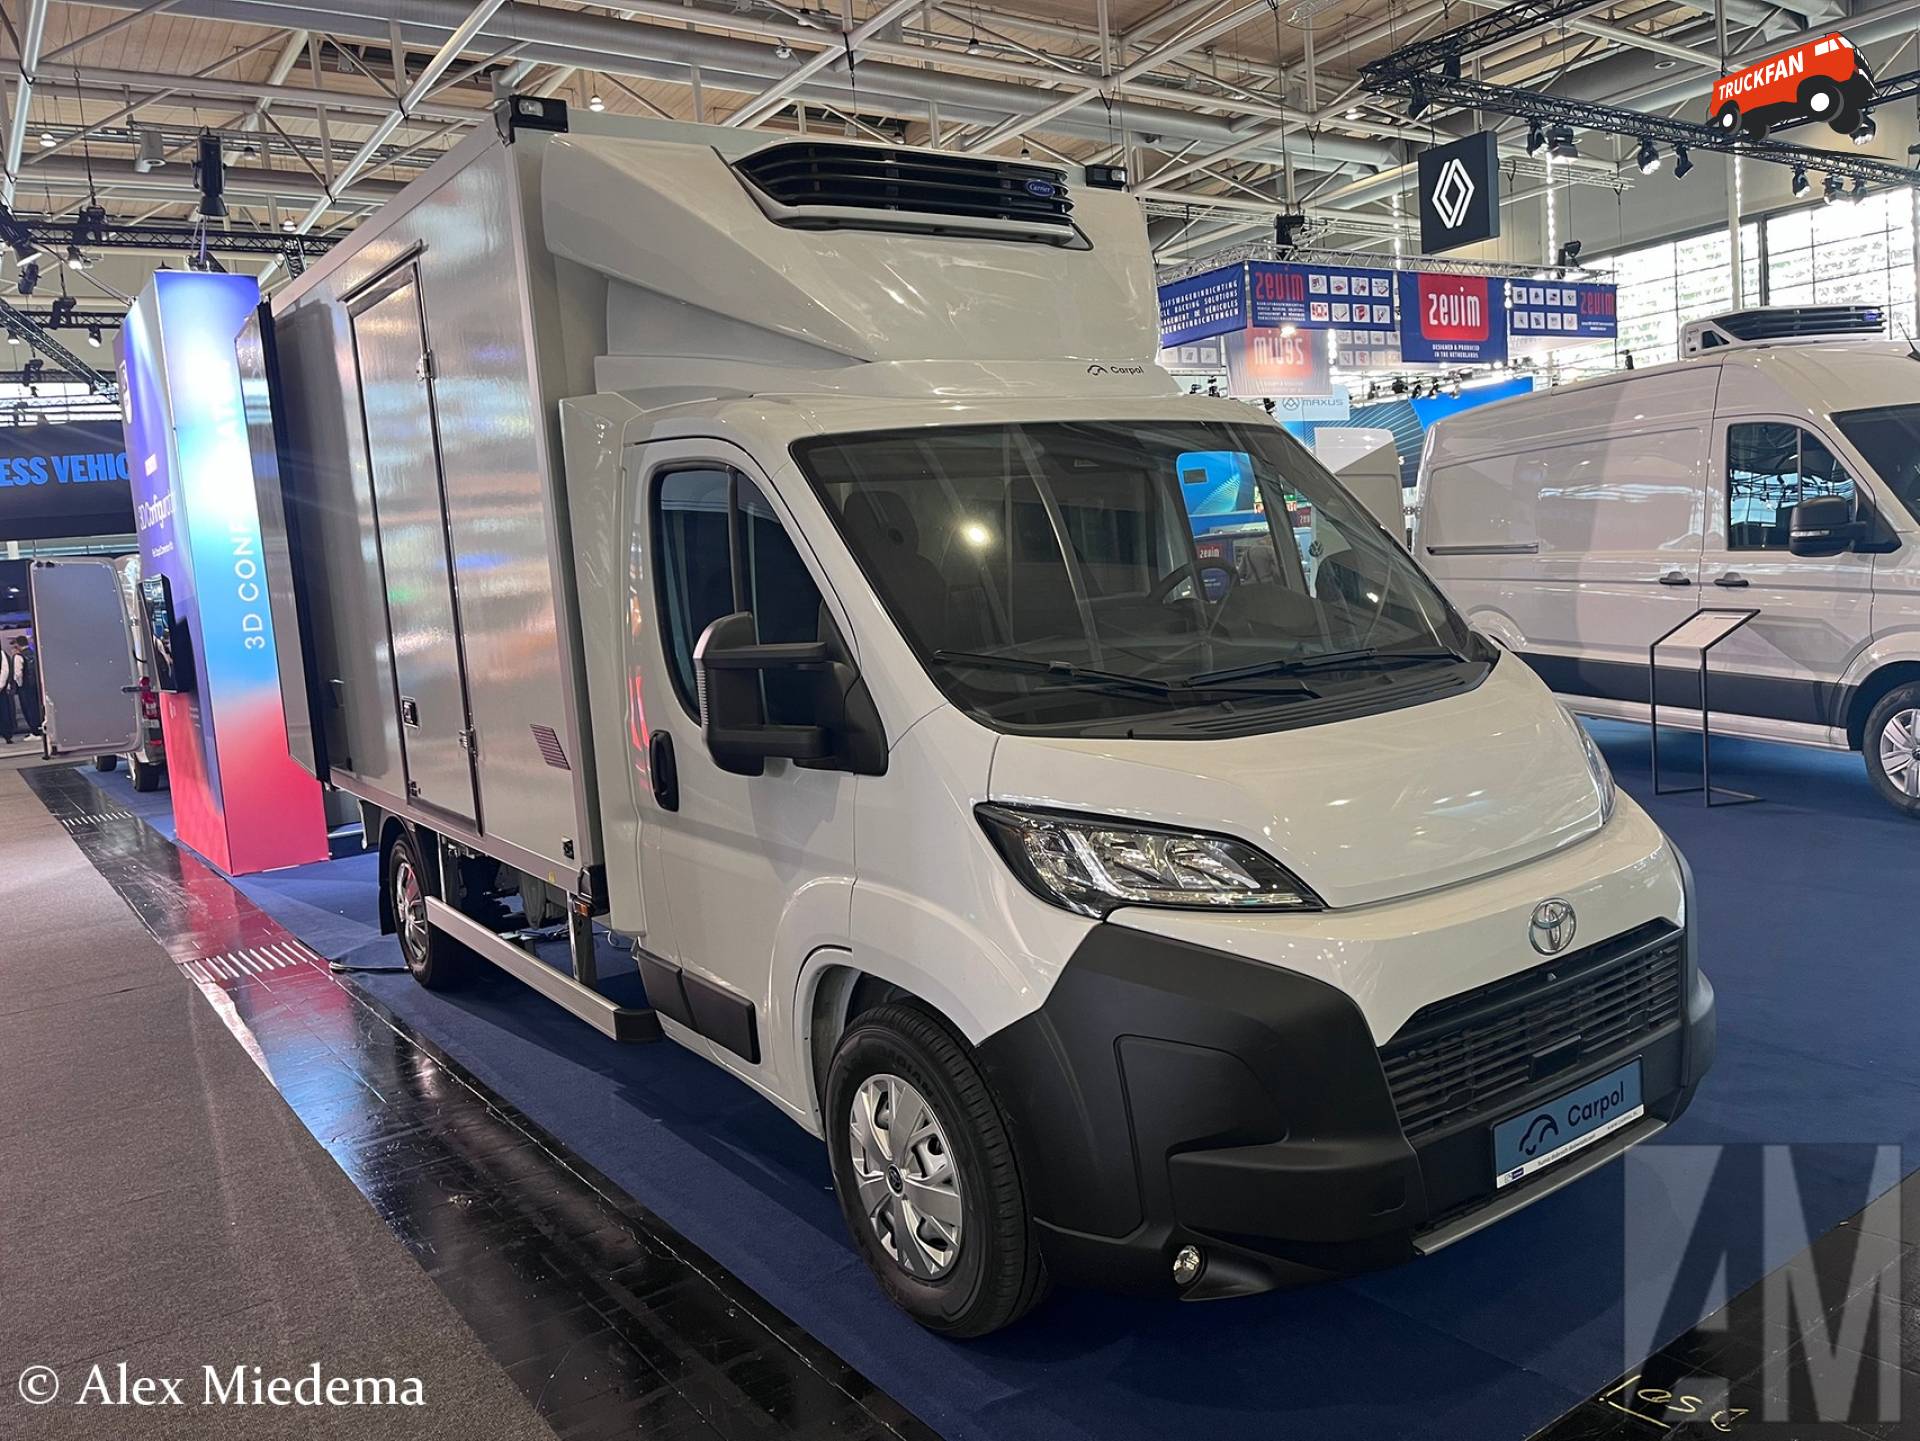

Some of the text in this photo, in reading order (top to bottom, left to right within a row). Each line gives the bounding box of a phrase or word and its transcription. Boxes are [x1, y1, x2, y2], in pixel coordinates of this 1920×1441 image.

[1204, 289, 1238, 305] SOLUTIONS
[1110, 365, 1144, 376] Carpol
[0, 456, 49, 487] ESS
[243, 613, 265, 649] 3D
[1567, 1081, 1625, 1128] Carpol
